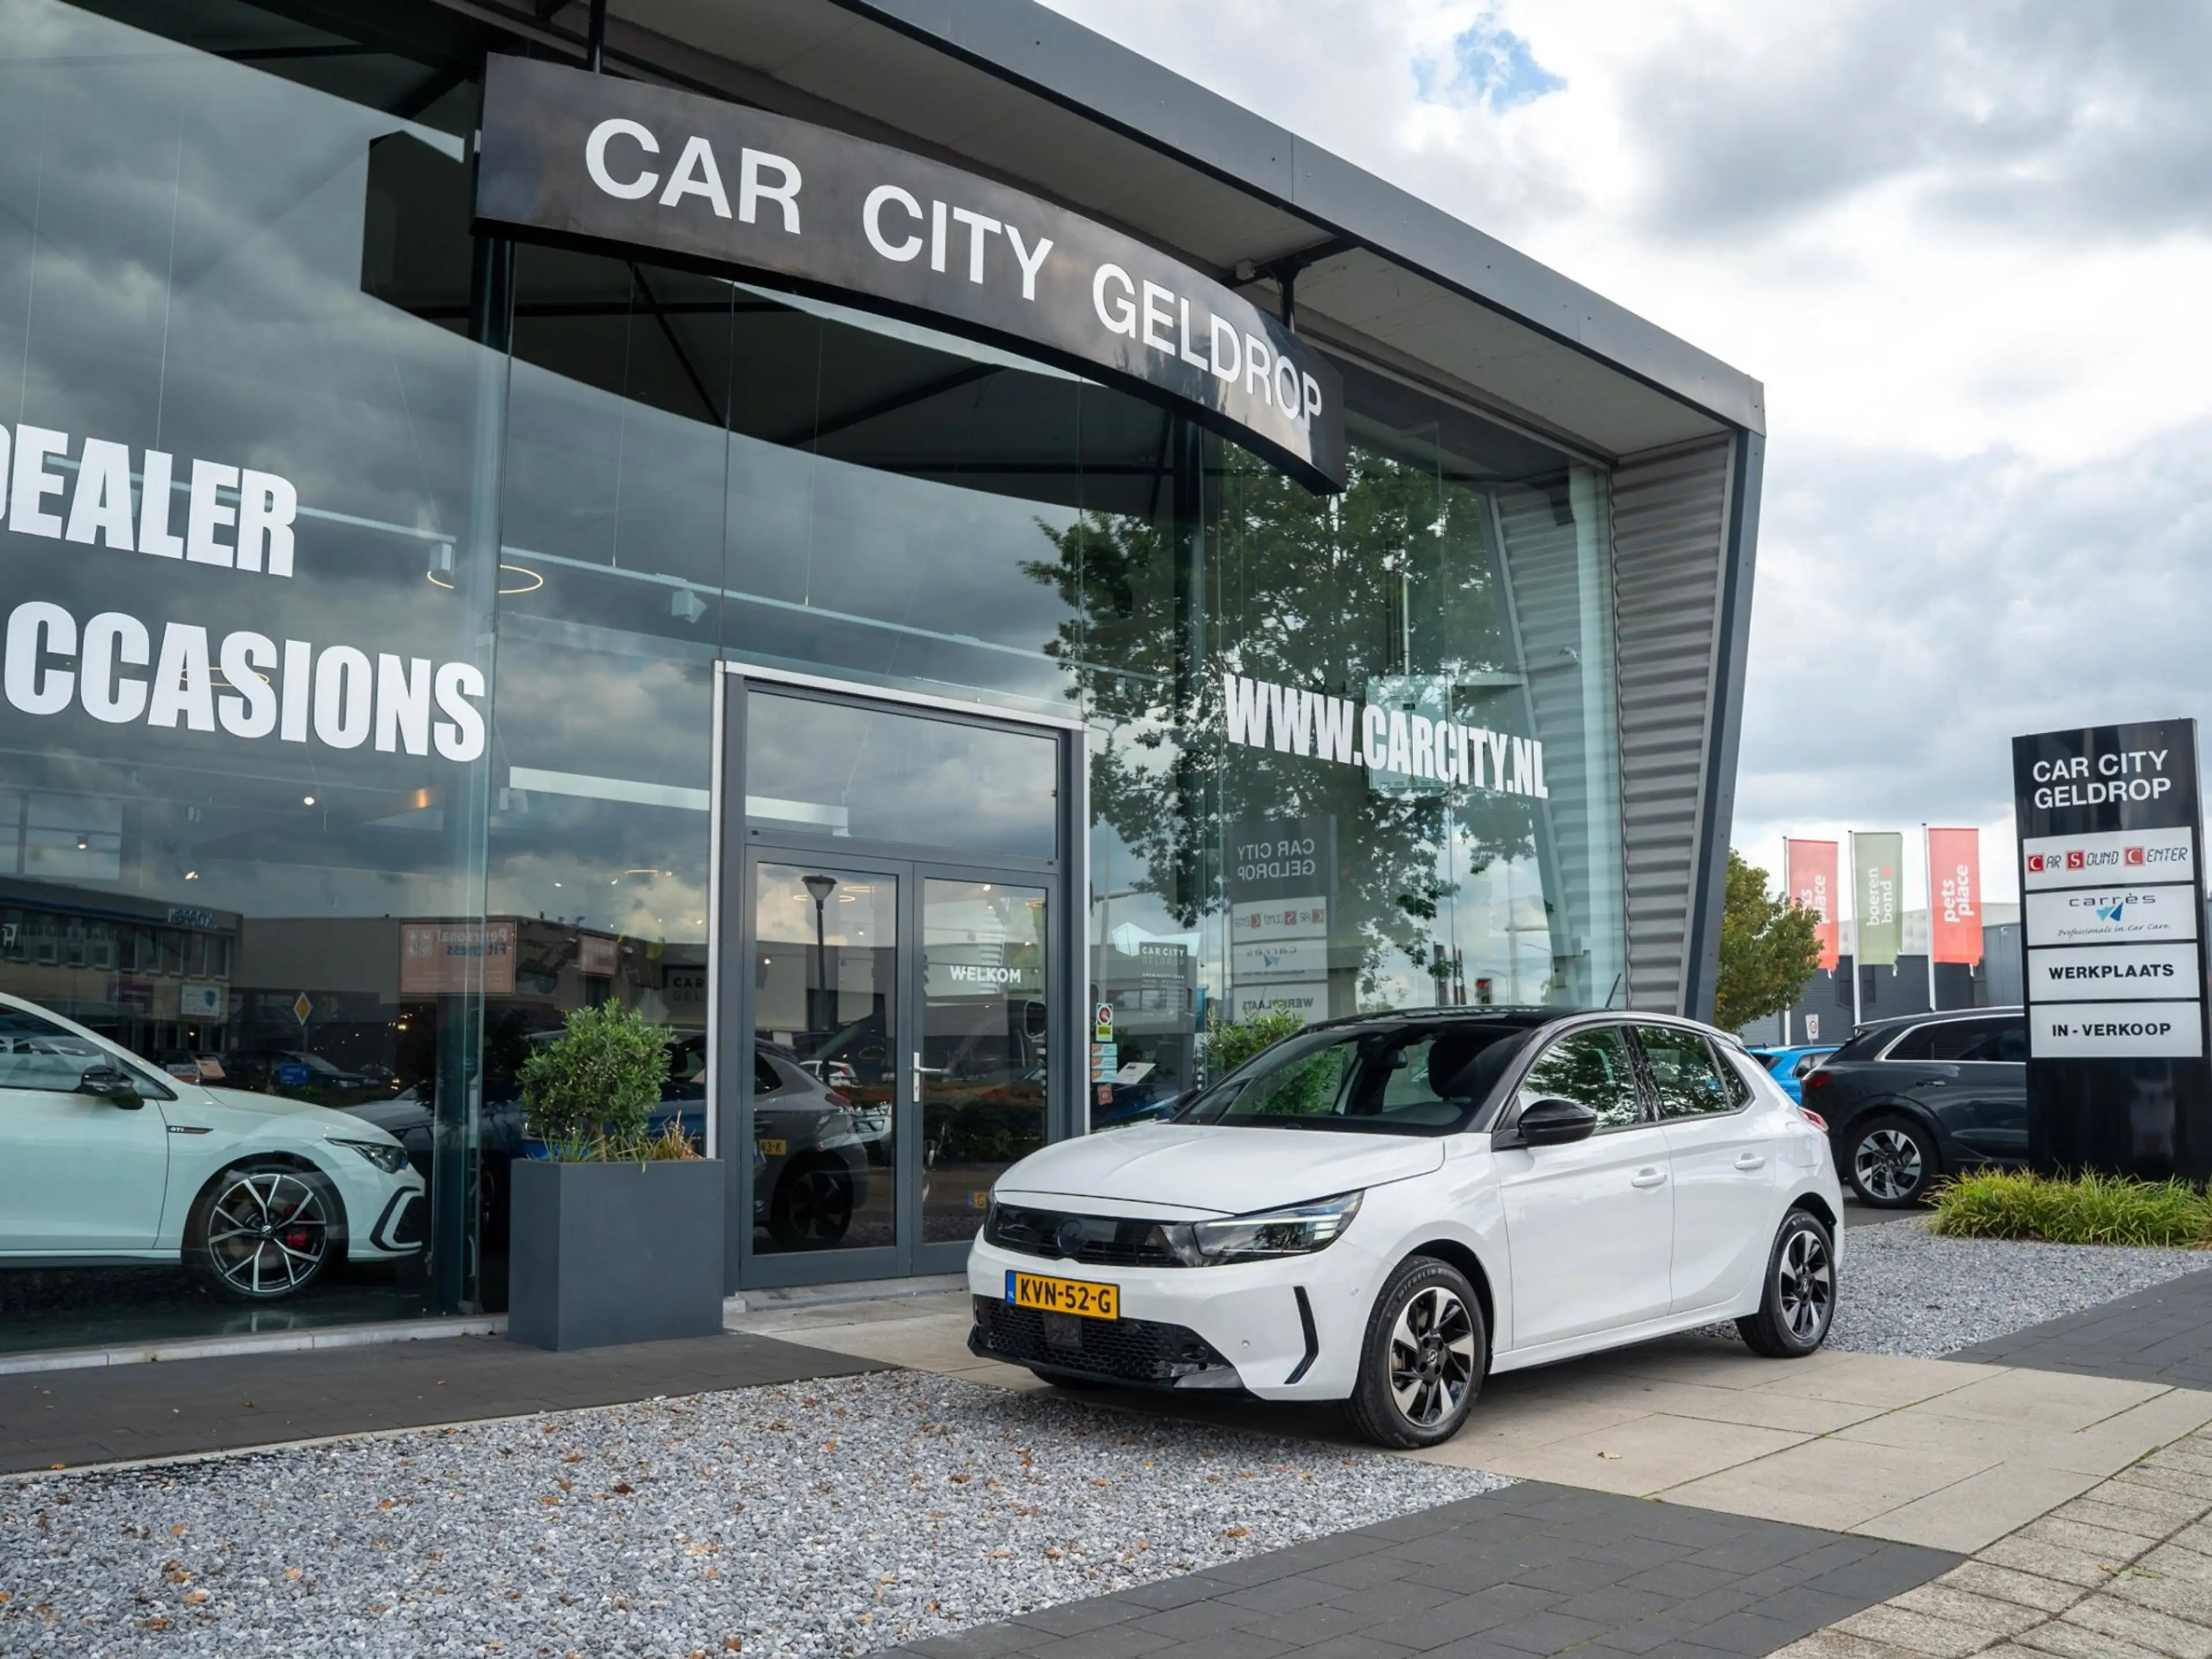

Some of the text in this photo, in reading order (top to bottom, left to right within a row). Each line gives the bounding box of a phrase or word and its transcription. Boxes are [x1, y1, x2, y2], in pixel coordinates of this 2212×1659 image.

[585, 119, 1322, 429] CAR CITY GELDROP
[0, 423, 297, 577] EALER
[4, 601, 485, 762] CCASIONS
[1224, 674, 1548, 799] WWW.CARCITY.NL
[2033, 749, 2168, 782] CAR CITY
[2034, 778, 2171, 809] GELDROP
[2028, 847, 2188, 872] CAR SOUND CENTER
[1866, 868, 1880, 926] boeren
[1881, 880, 1893, 924] bond
[1941, 879, 1960, 922] pets
[1957, 865, 1975, 916] place
[1142, 946, 1184, 957] CAR CITY
[2049, 964, 2174, 979] WERKPLAATS
[949, 965, 1021, 983] WELKOM
[1020, 1278, 1111, 1313] KVN-52-G
